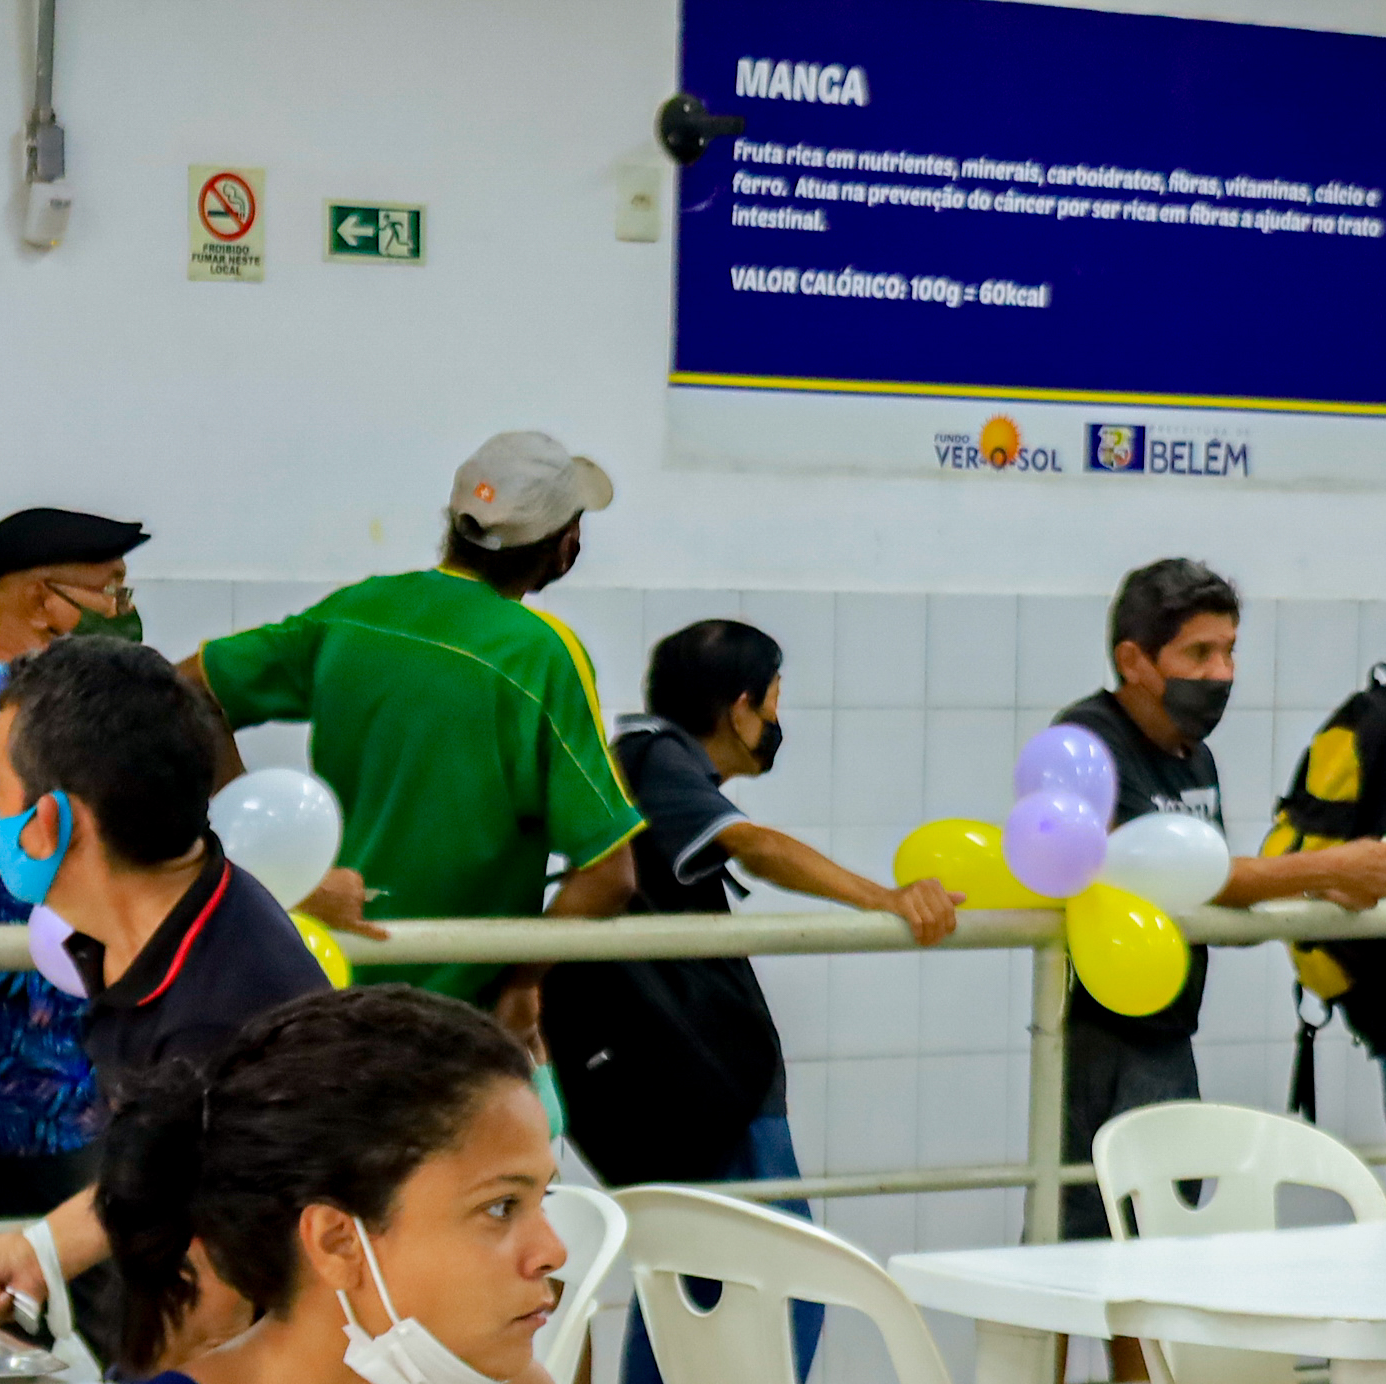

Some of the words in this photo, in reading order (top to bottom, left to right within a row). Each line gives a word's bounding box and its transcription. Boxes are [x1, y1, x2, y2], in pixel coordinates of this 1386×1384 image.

[735, 57, 869, 107] MANGA
[733, 138, 784, 165] Fruta
[786, 141, 824, 167] rica
[826, 149, 856, 169] em
[858, 149, 960, 181] nutrientes,
[961, 155, 1044, 187] minerais,
[1047, 162, 1164, 195] carboidratos,
[1168, 168, 1221, 199] fibras,
[1225, 174, 1313, 206] vitaminas,
[1315, 180, 1365, 207] cálcio
[1366, 188, 1382, 207] e
[731, 202, 829, 231] intestinal.
[732, 169, 788, 197] ferro.
[794, 174, 840, 200] Atua
[841, 182, 865, 203] na
[867, 182, 966, 212] prevenção
[967, 187, 993, 211] do
[994, 187, 1057, 214] câncer
[1057, 197, 1090, 220] por
[1091, 199, 1122, 219] ser
[1123, 197, 1159, 221] rica
[1159, 204, 1188, 224] em
[1189, 201, 1240, 227] fibras
[1240, 210, 1254, 229] a
[1254, 208, 1312, 234] ajudar
[1312, 214, 1336, 234] no
[1337, 214, 1385, 237] trato
[192, 253, 225, 264] FUMAR
[228, 256, 260, 266] NESTE
[203, 243, 249, 255] PROIBIDO
[210, 264, 241, 276] LOCAL
[730, 264, 799, 294] VALOR
[800, 264, 908, 300] CALÓRICO:
[910, 275, 963, 308] 100g
[963, 287, 978, 302] =
[979, 279, 1051, 308] 60kcal
[934, 434, 970, 444] FUNDO
[934, 444, 1062, 473] VER-O-SOL
[1149, 438, 1250, 477] BELÉM
